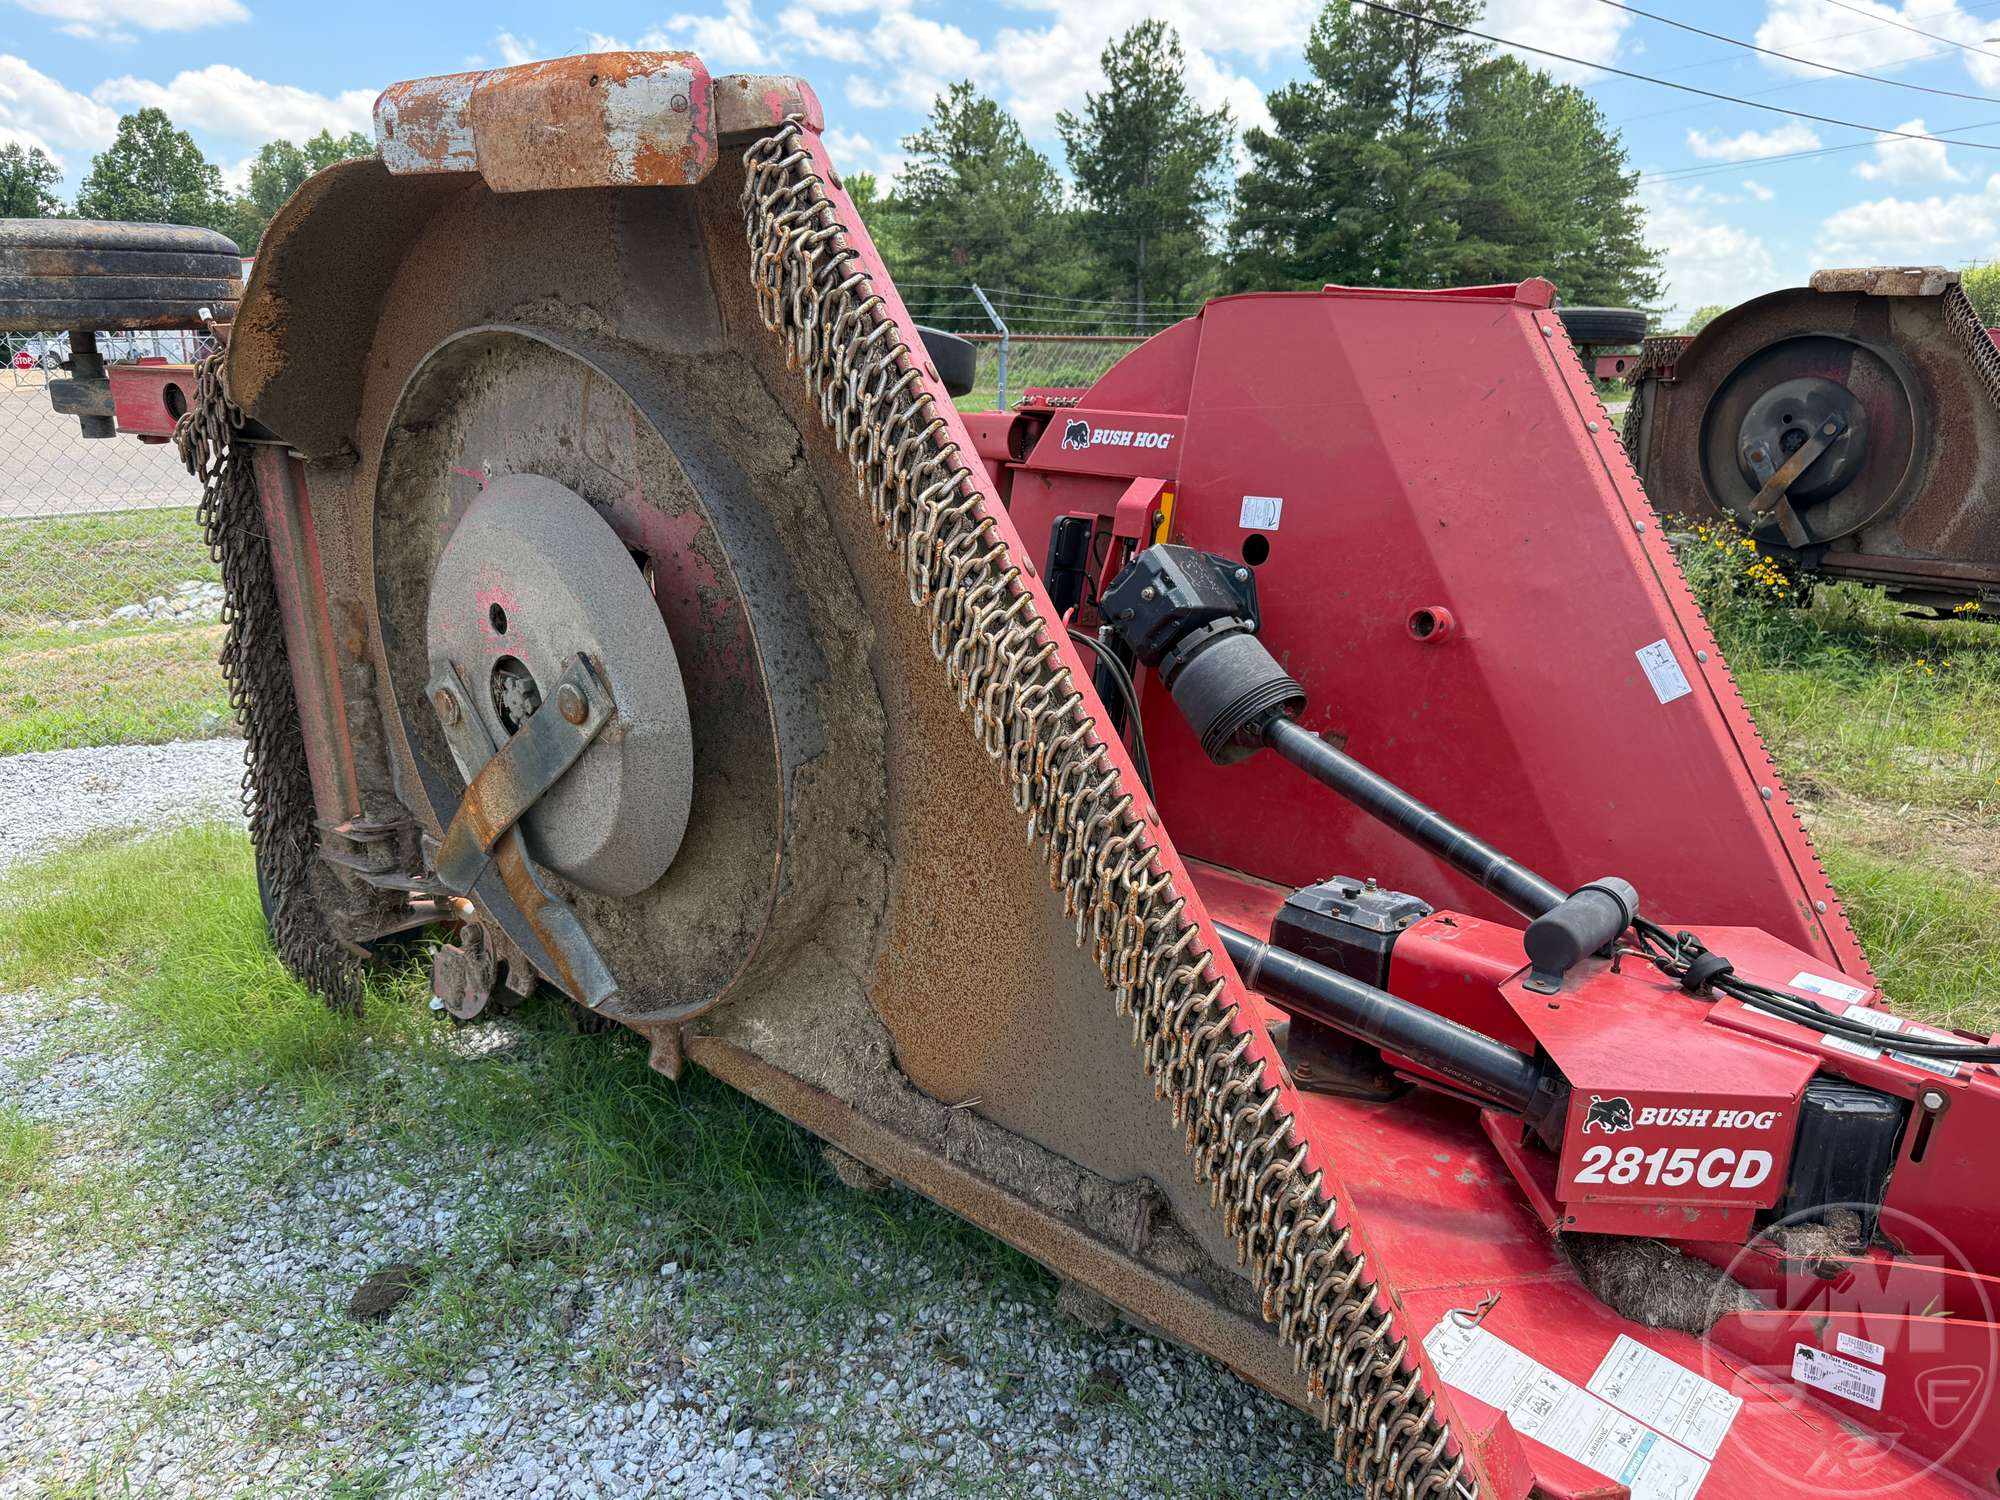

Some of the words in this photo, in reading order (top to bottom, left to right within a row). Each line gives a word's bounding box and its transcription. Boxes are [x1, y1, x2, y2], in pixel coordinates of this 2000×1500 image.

[15, 357, 32, 365] STOP
[1091, 429, 1134, 447] BUSH
[1133, 431, 1171, 449] HOG
[1636, 1107, 1714, 1128] BUSH
[1712, 1110, 1776, 1130] HOG
[1573, 1145, 1773, 1188] 2815CD
